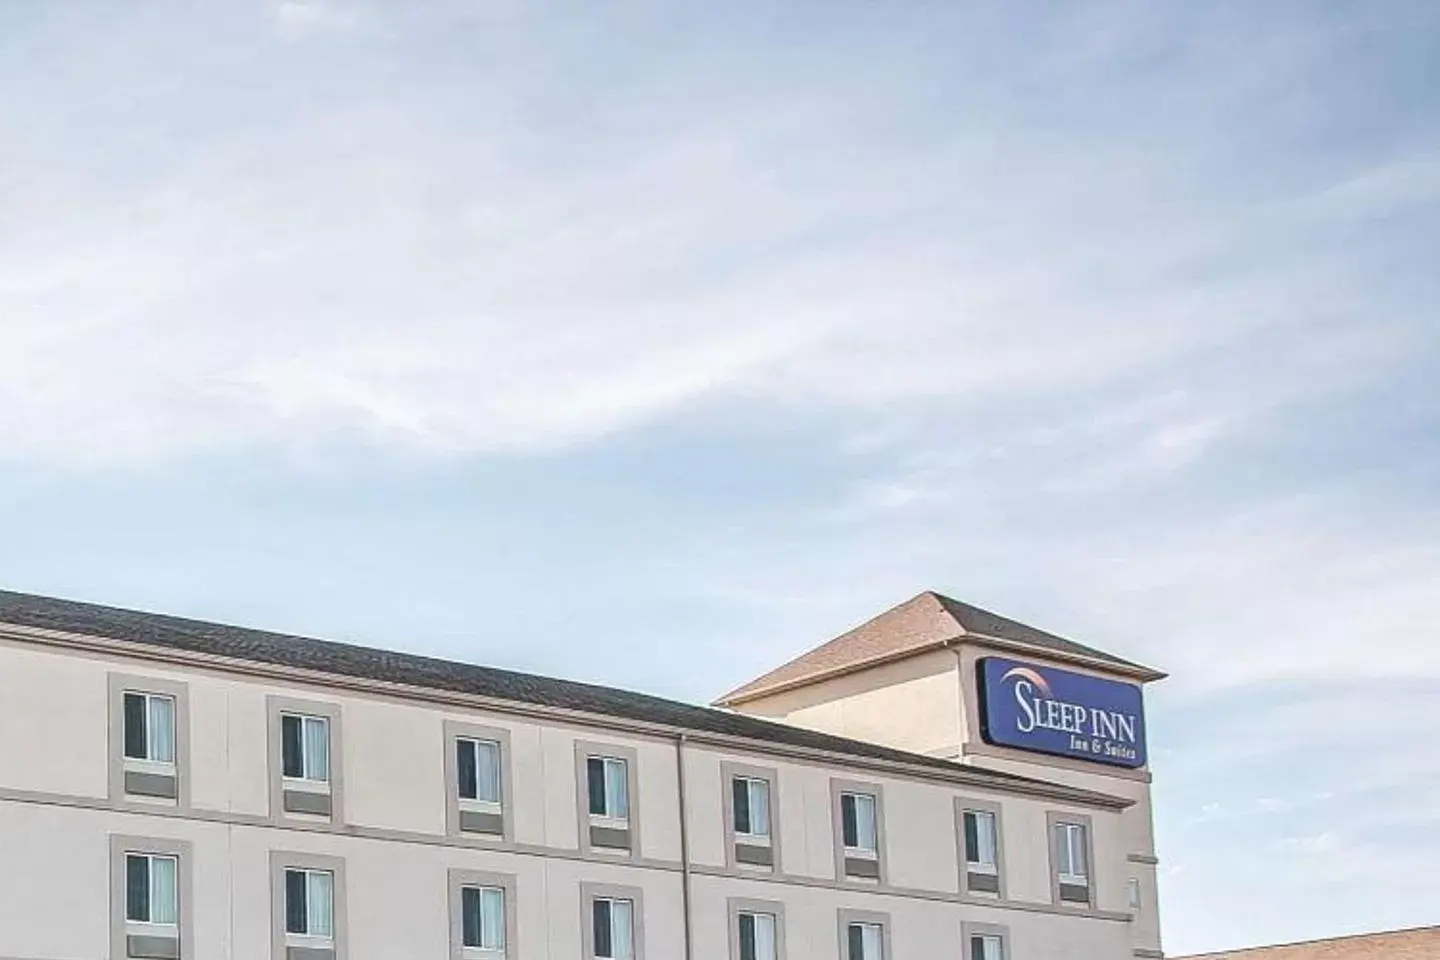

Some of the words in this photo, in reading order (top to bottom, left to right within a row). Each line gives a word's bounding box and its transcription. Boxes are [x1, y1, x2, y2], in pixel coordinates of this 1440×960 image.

[1015, 681, 1087, 734] SLEEP
[1091, 708, 1136, 744] INN
[1070, 735, 1088, 751] Inn
[1092, 738, 1102, 754] &
[1105, 740, 1136, 760] Suites
